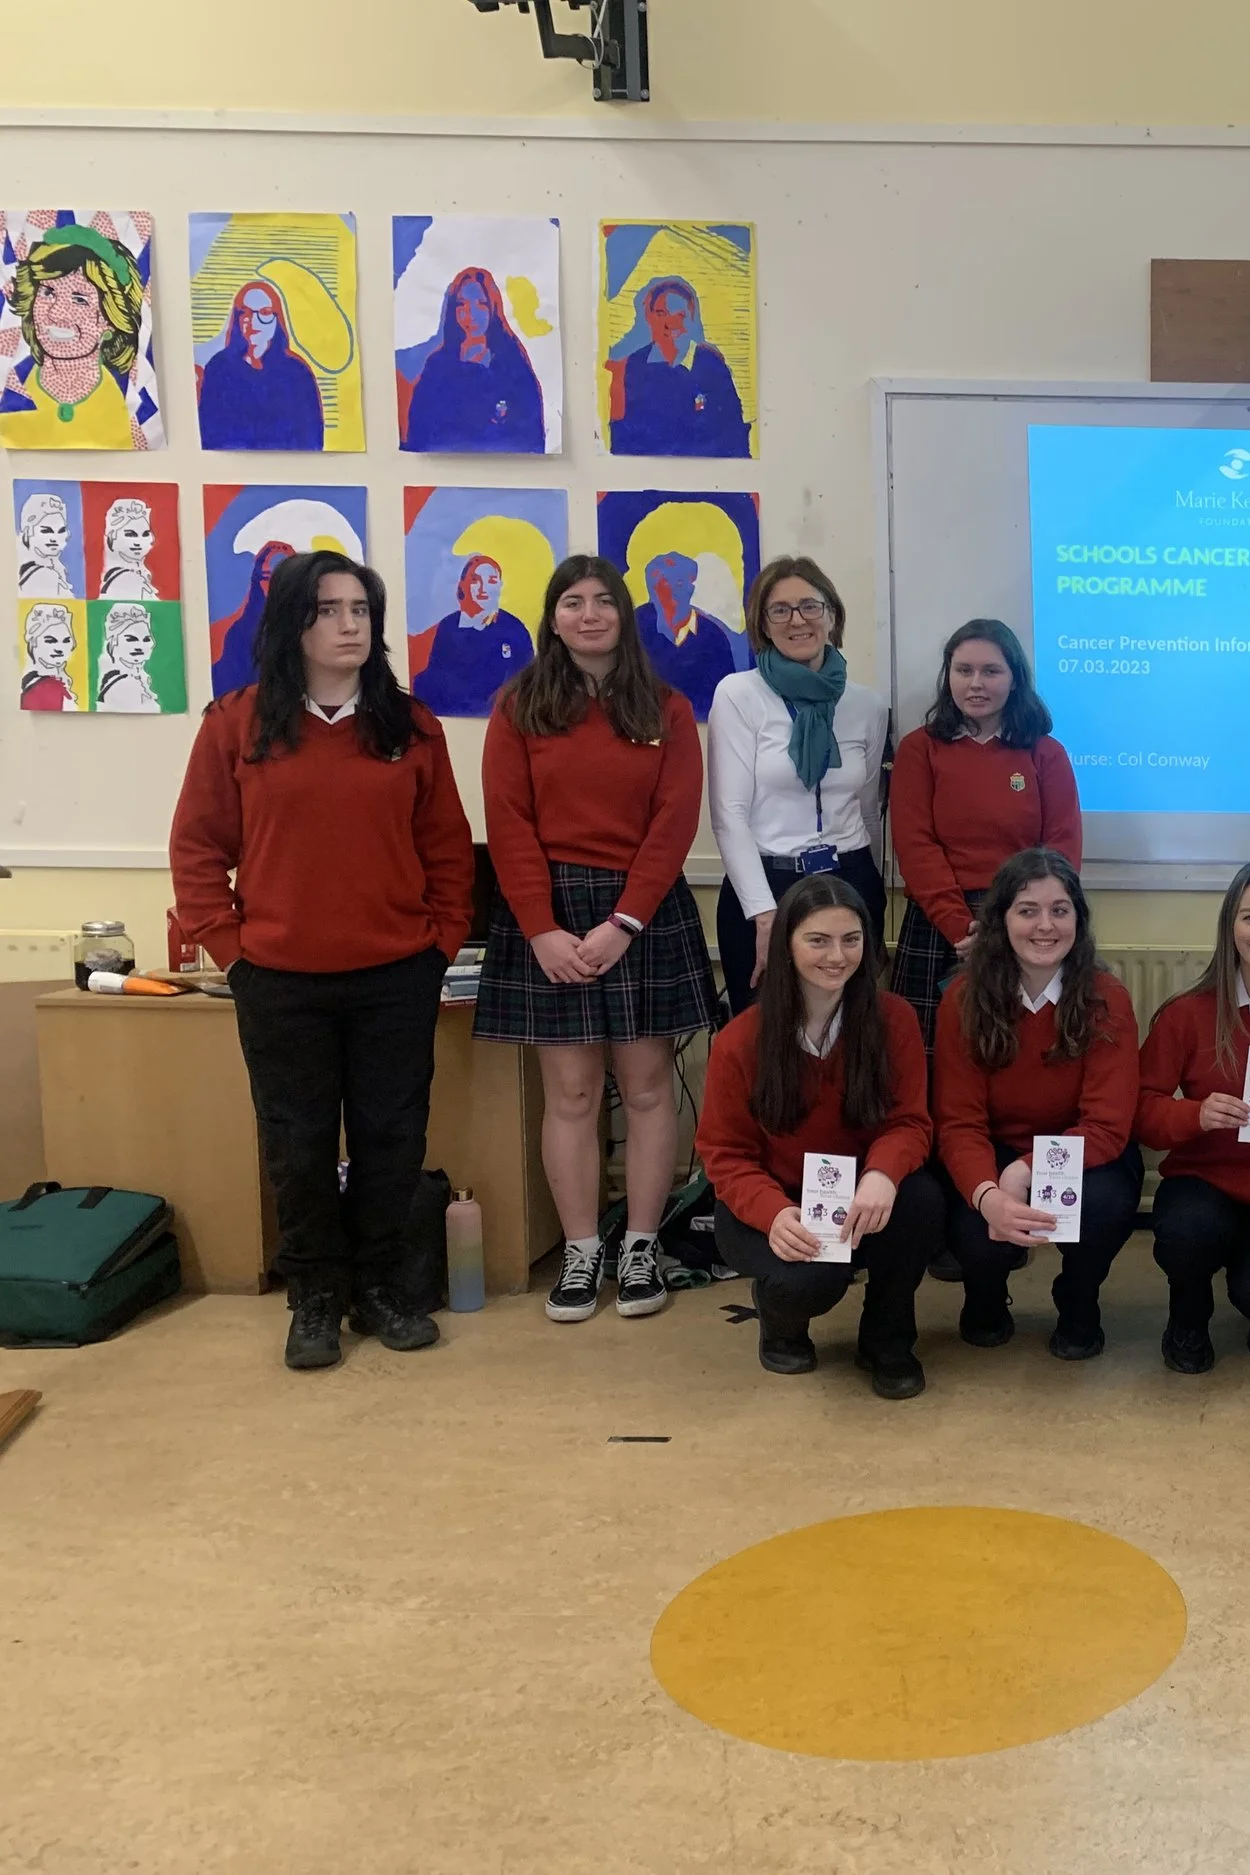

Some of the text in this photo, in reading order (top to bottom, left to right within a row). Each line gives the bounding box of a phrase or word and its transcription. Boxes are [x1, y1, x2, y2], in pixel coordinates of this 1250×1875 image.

[1175, 490, 1226, 509] Marie
[1056, 545, 1157, 565] SCHOOLS
[1163, 546, 1250, 567] CANCER
[1056, 576, 1208, 597] PROGRAMME
[1057, 635, 1116, 651] Cancer
[1120, 635, 1210, 652] Prevention
[1058, 659, 1150, 675] 07.03.2023
[1117, 752, 1142, 766] Col
[1147, 752, 1210, 769] Conway
